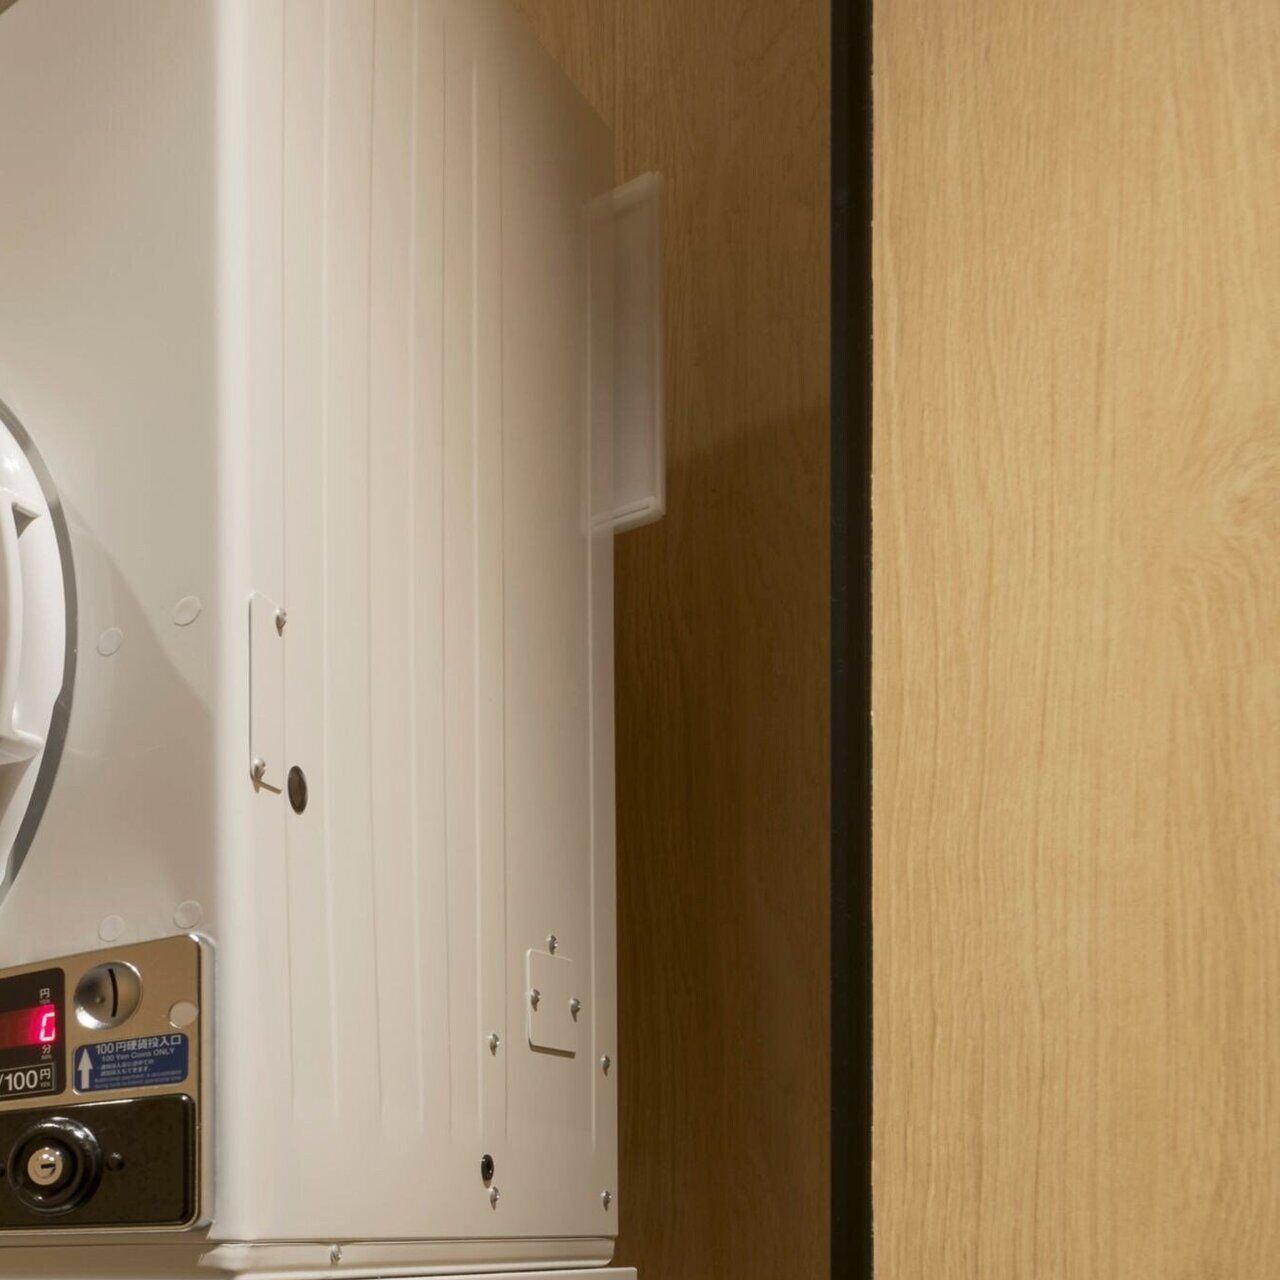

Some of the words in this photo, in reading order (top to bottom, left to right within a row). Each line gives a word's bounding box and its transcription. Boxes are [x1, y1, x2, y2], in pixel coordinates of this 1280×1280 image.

[40, 987, 50, 999] 円
[42, 1044, 51, 1054] 分
[153, 1048, 175, 1057] ONLY
